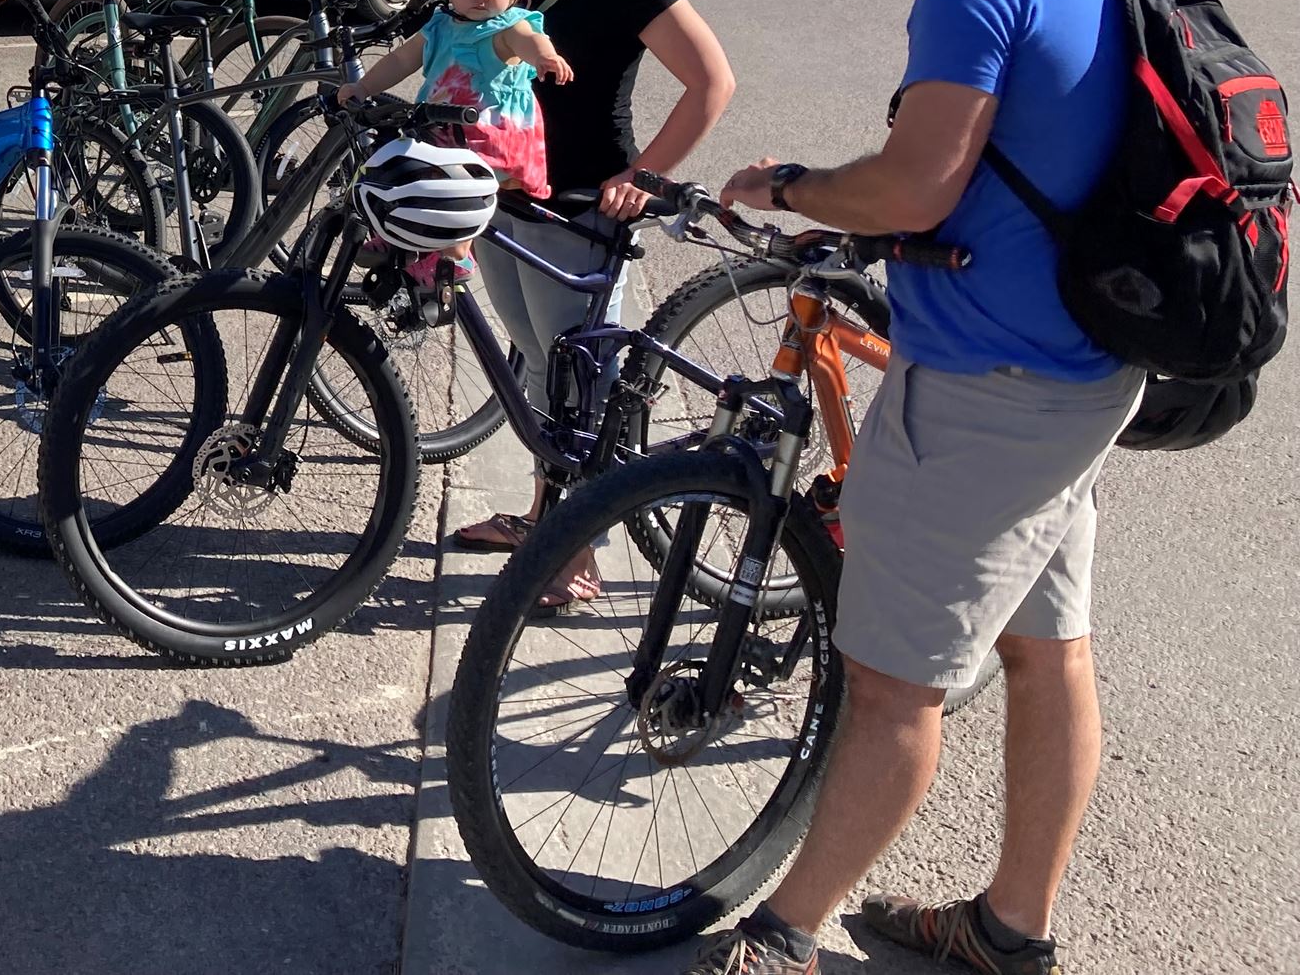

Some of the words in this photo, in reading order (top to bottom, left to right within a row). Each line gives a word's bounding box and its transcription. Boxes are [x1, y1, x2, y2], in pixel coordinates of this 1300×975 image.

[15, 527, 42, 538] XR3
[224, 617, 313, 651] MAXXIS
[800, 703, 824, 760] CANE
[814, 598, 830, 664] CREEK
[603, 918, 669, 935] BONTRAGER
